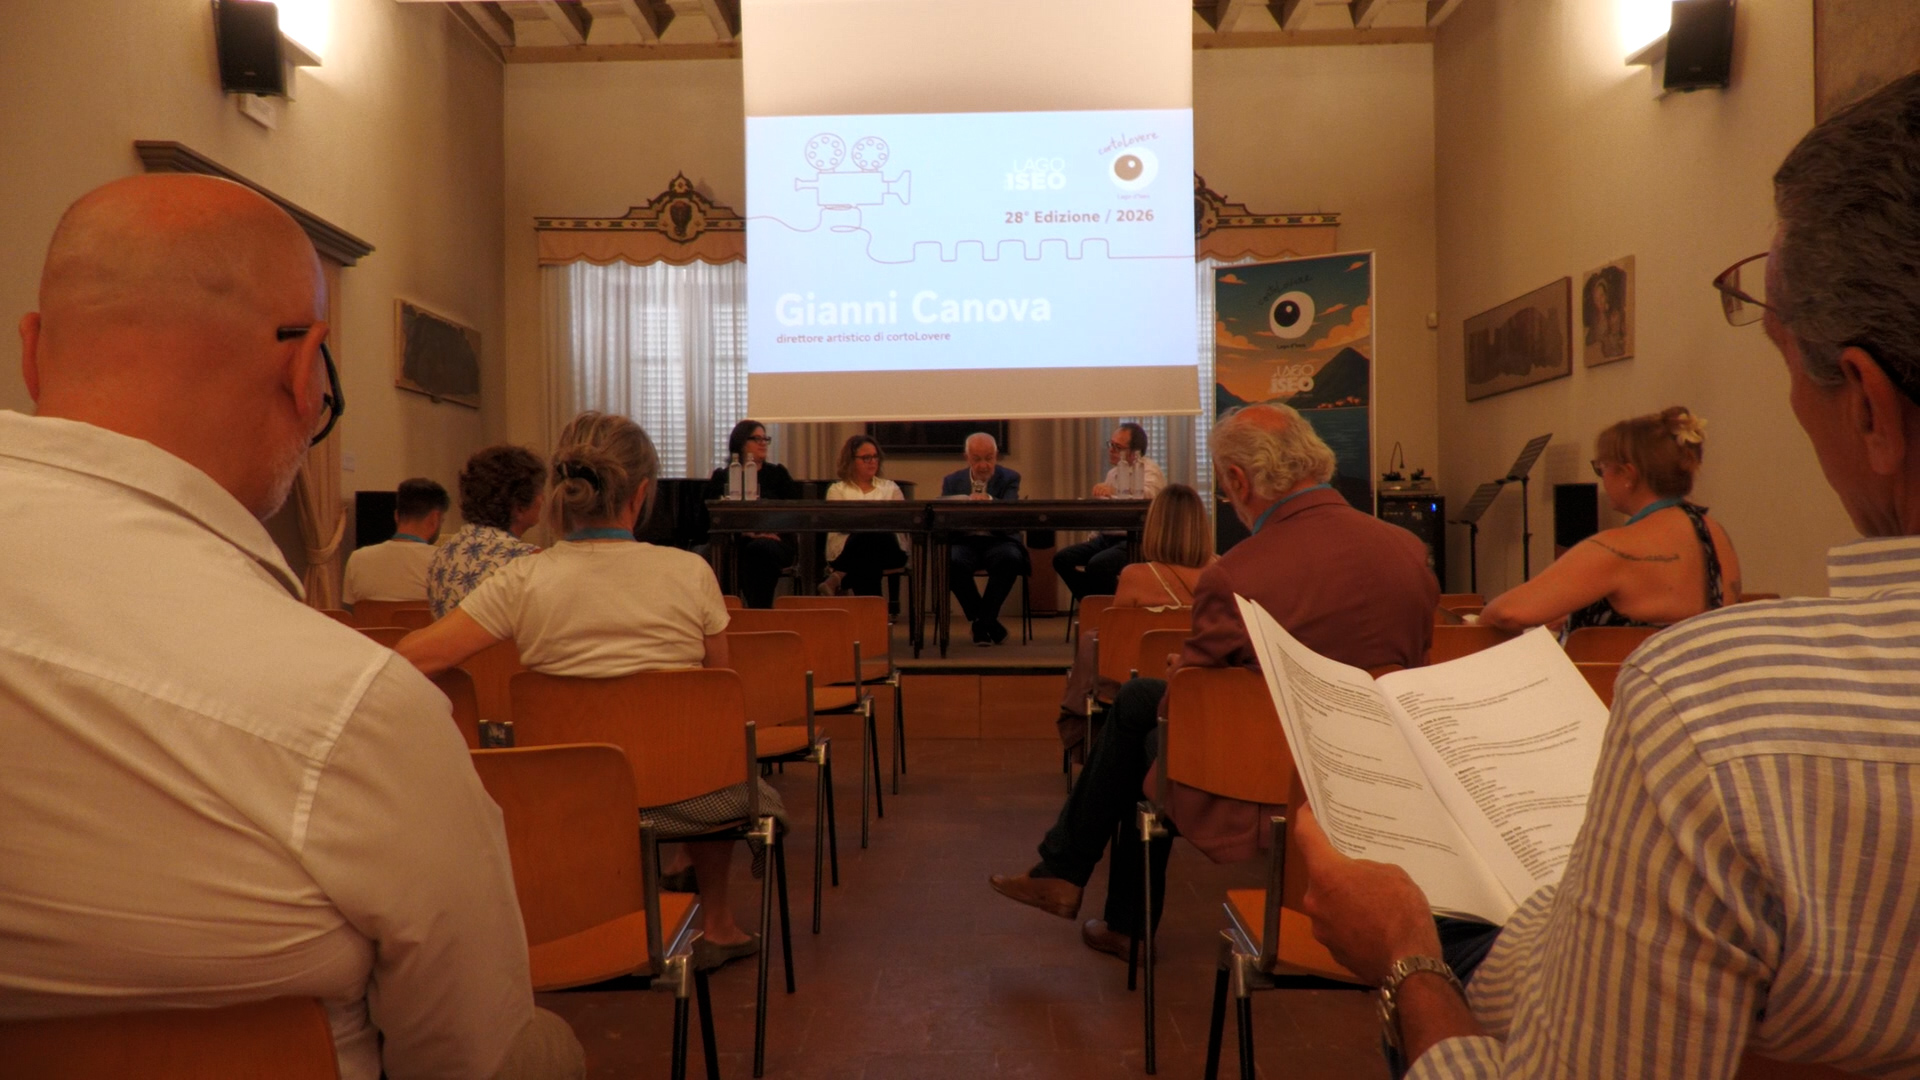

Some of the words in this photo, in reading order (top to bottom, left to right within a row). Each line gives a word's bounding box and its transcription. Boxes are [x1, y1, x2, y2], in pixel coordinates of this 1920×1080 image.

[1012, 156, 1066, 173] LAGO
[1006, 172, 1067, 190] ISEO
[1034, 209, 1101, 224] Edizione
[1105, 209, 1112, 224] /
[1116, 209, 1154, 223] 2026
[775, 290, 898, 327] Gianni
[911, 289, 1052, 324] Canova
[776, 333, 824, 344] direttore
[826, 332, 871, 343] artistico
[873, 331, 885, 342] di
[886, 331, 952, 342] cortoLovere
[1276, 364, 1314, 377] LAGO
[1271, 376, 1314, 393] ISEO
